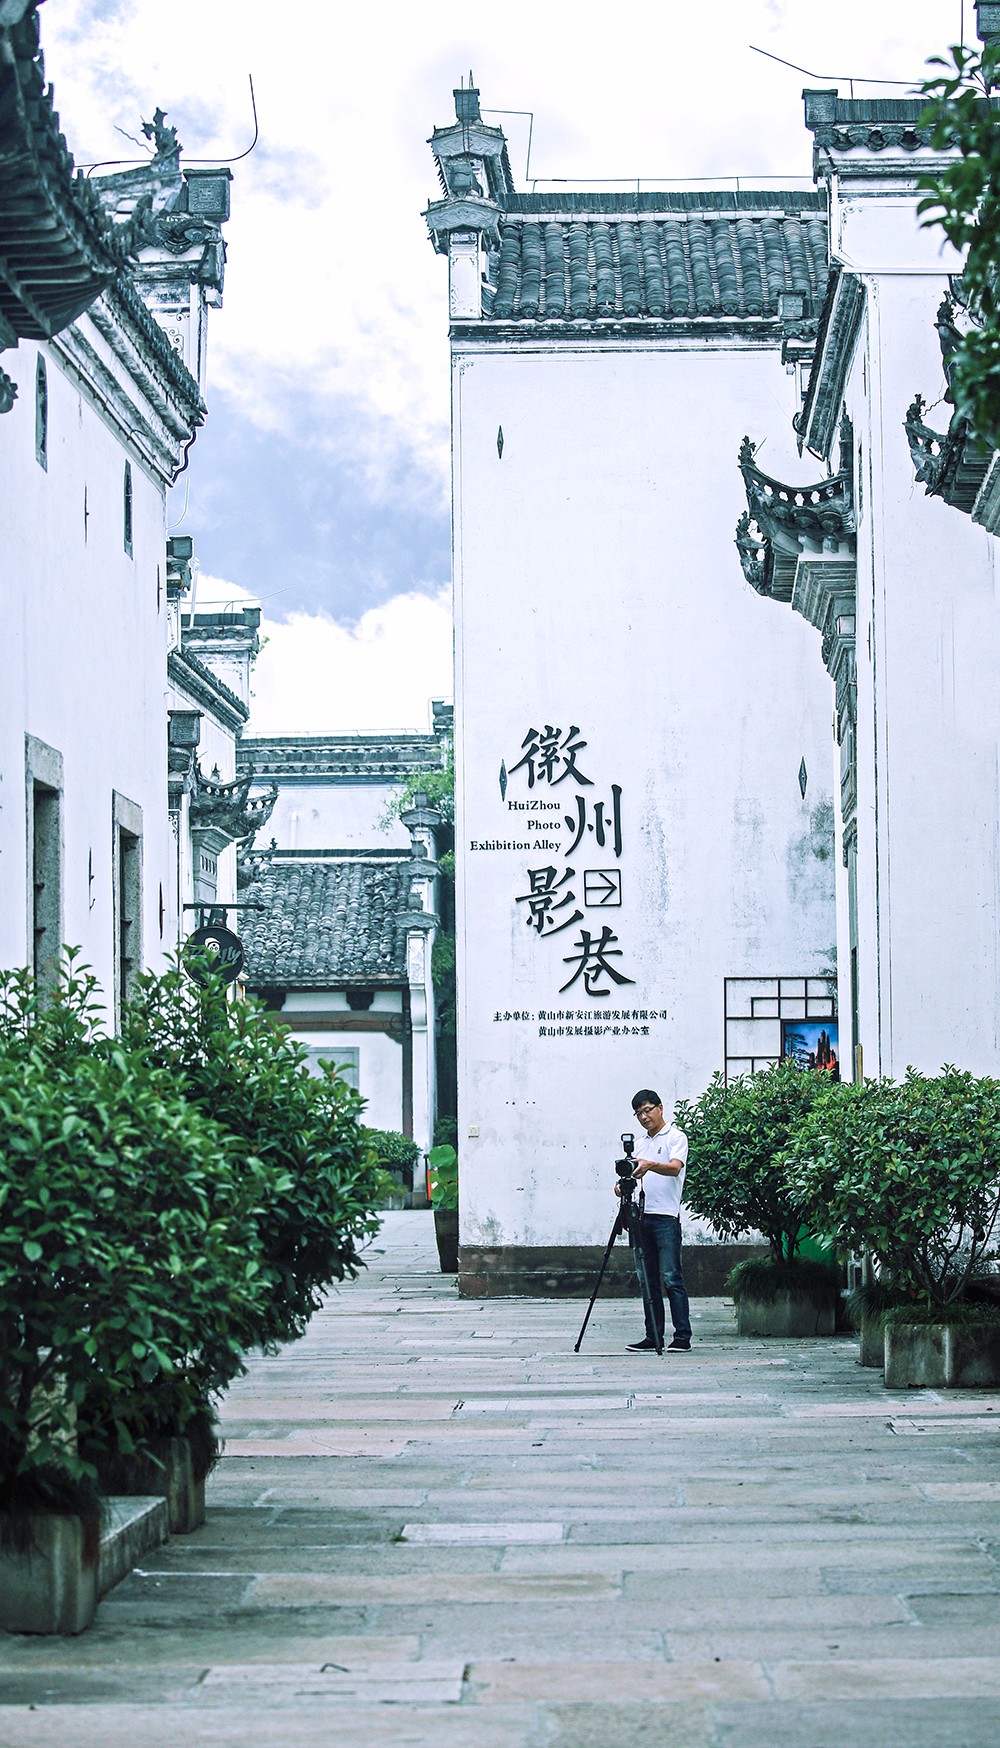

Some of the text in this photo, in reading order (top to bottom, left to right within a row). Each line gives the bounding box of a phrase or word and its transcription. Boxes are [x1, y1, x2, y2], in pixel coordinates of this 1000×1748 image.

[507, 799, 561, 811] HuiZhou
[527, 819, 561, 830] Photo
[470, 840, 562, 853] Exhibition Alley
[538, 1025, 650, 1038] 黄山市发展摄影产业办公室
